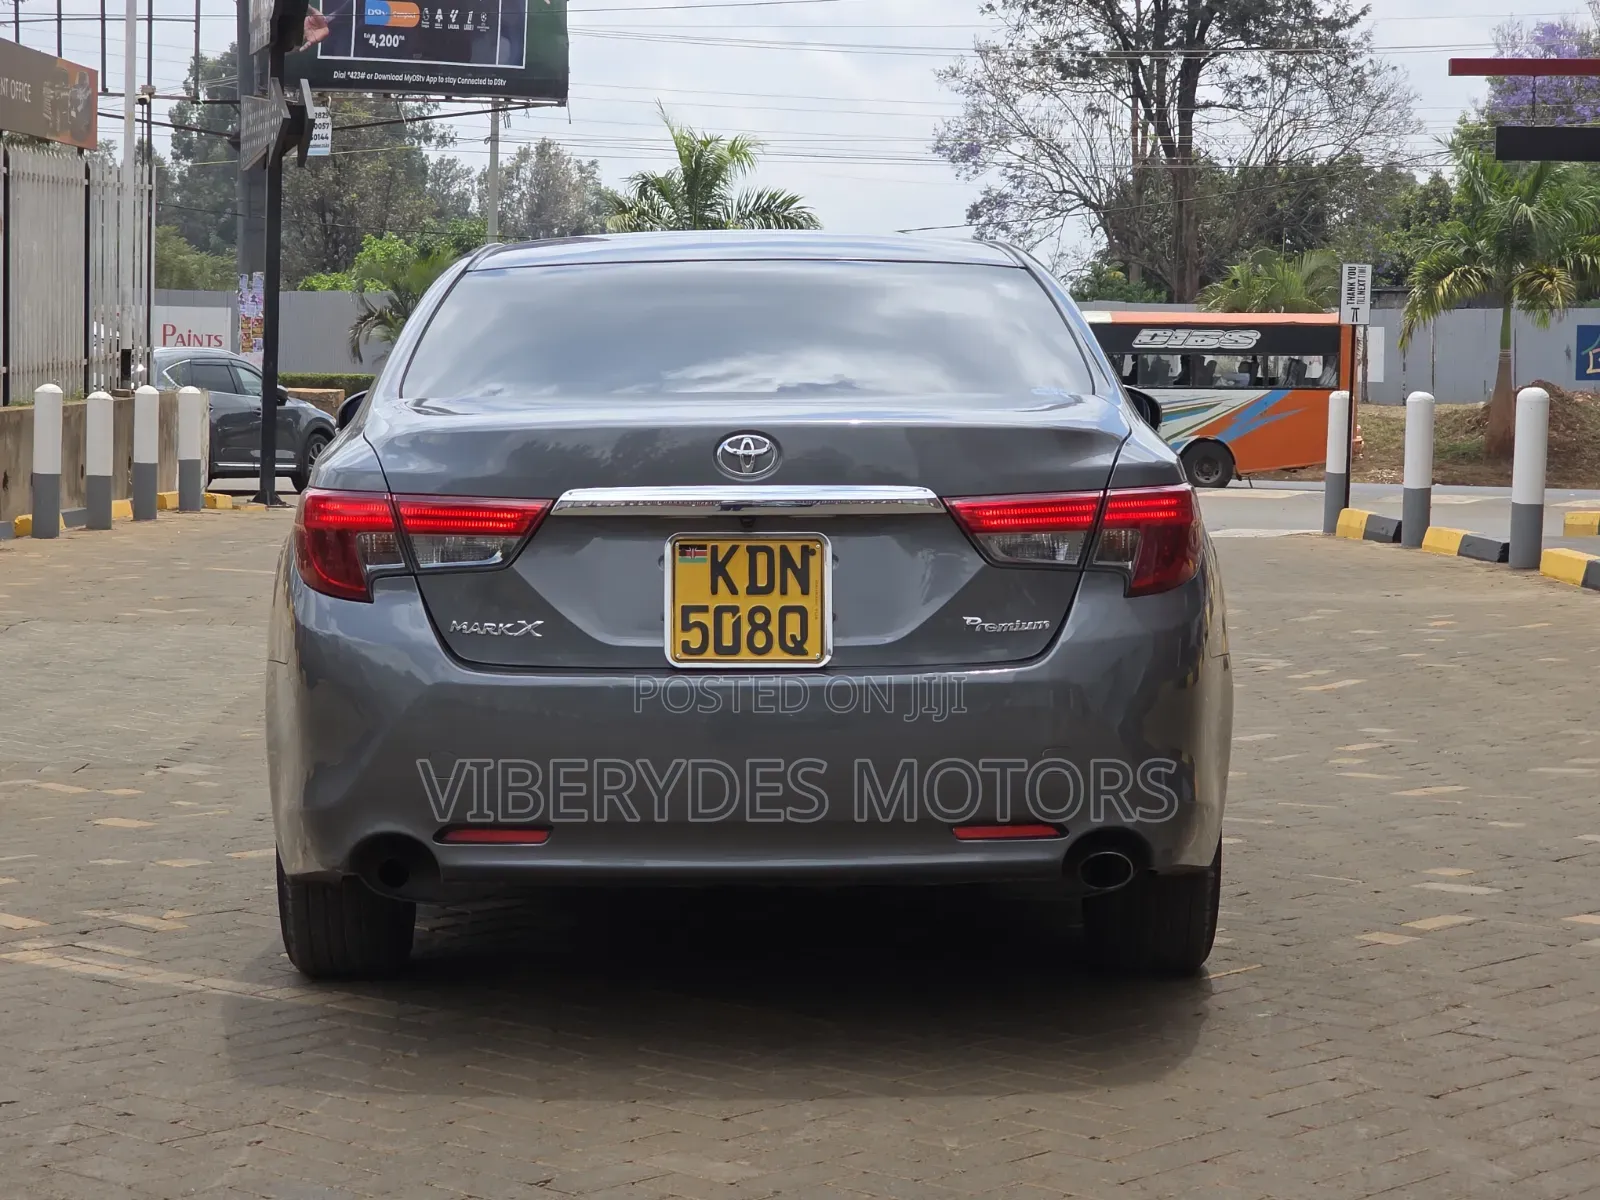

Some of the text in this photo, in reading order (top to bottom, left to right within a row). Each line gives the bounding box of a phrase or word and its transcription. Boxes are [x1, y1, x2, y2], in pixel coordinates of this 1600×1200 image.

[368, 33, 399, 49] 4,200
[333, 70, 347, 79] Dial
[374, 72, 404, 81] Download
[426, 74, 438, 84] App
[438, 75, 444, 83] to
[445, 76, 457, 86] stay
[457, 76, 487, 86] Connected
[487, 78, 493, 86] to
[493, 78, 507, 86] DStv
[10, 79, 32, 103] OFFICE
[1346, 266, 1357, 305] THANK YOU
[1357, 279, 1366, 296] NEXT
[710, 544, 810, 596] KDN
[680, 604, 809, 656] 508Q
[962, 616, 1051, 633] Premium
